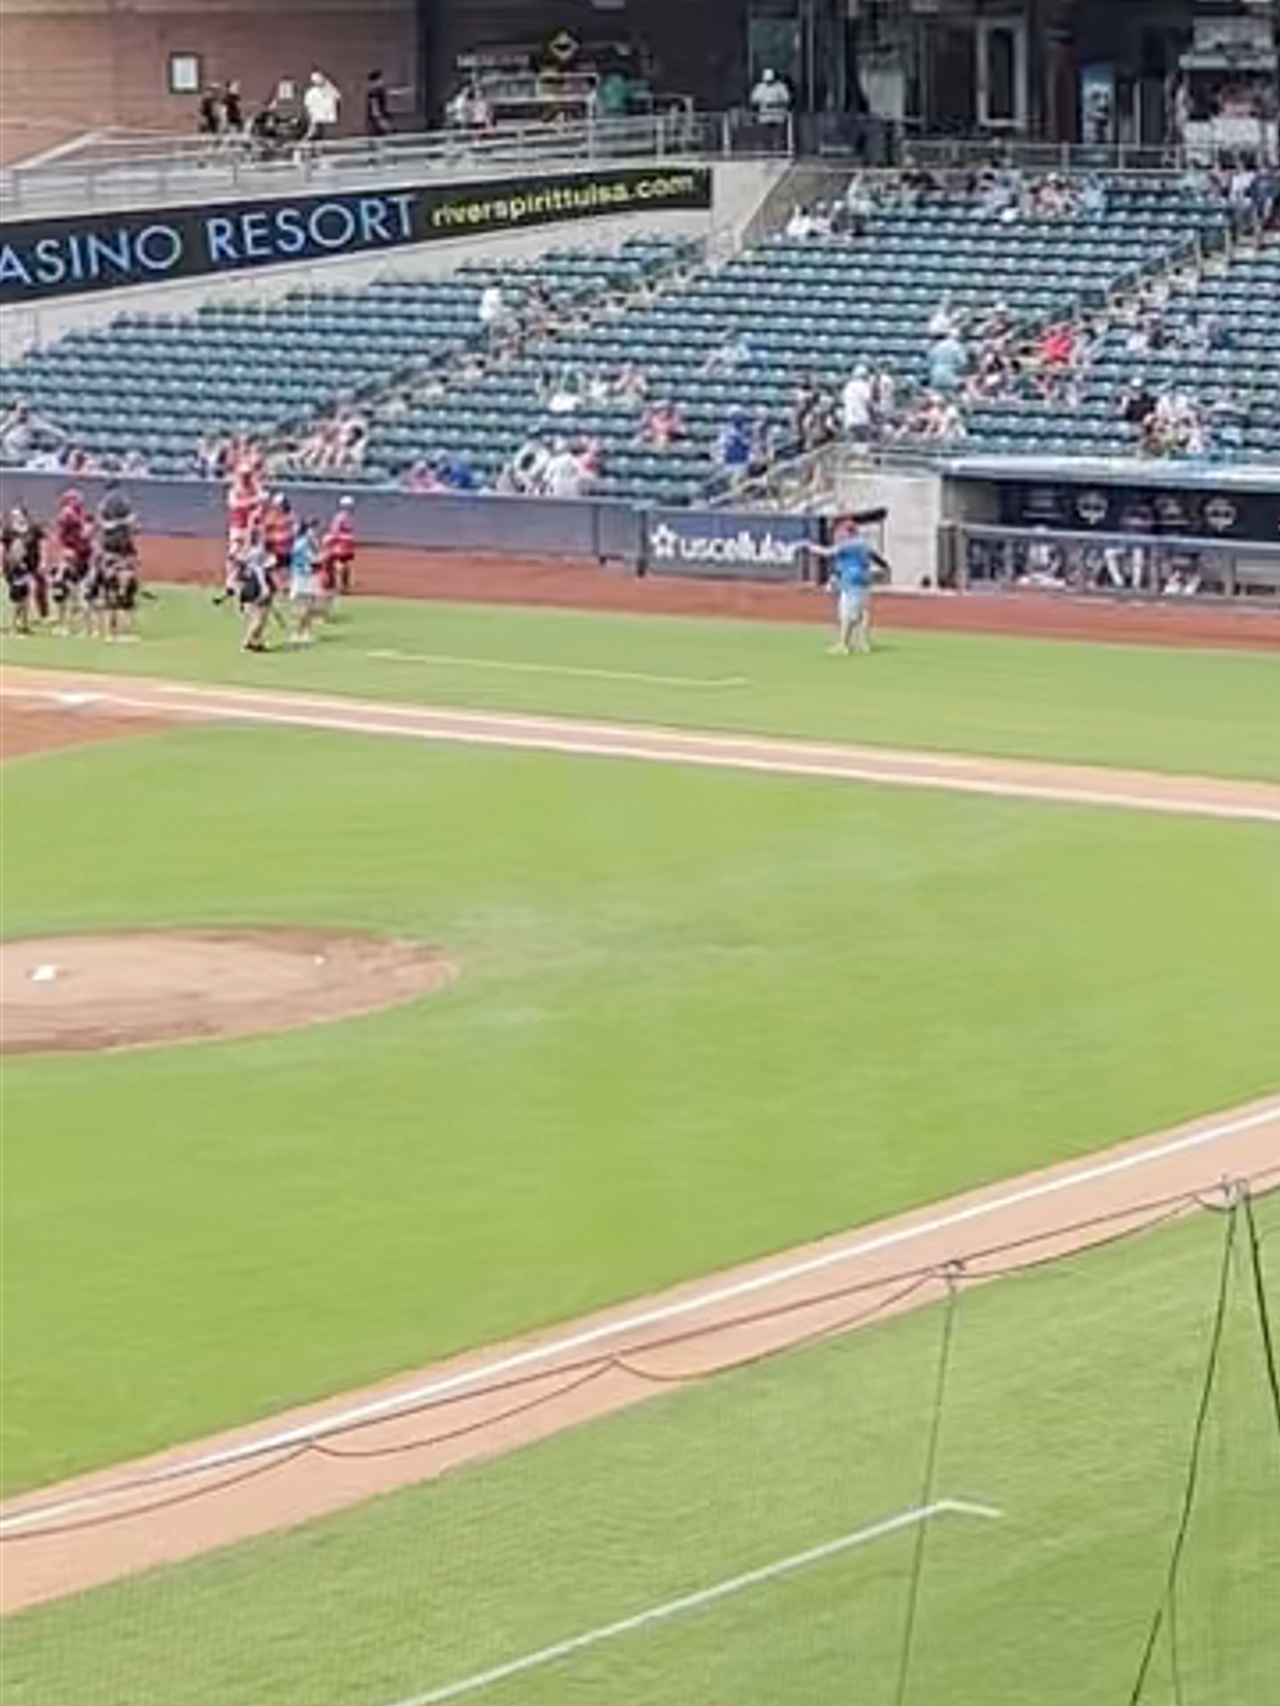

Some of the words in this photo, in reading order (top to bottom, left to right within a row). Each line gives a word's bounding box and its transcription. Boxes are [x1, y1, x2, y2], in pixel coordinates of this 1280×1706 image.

[0, 224, 182, 284] ASINO
[205, 196, 418, 262] RESORT
[432, 175, 694, 227] riverspirittulsa.com
